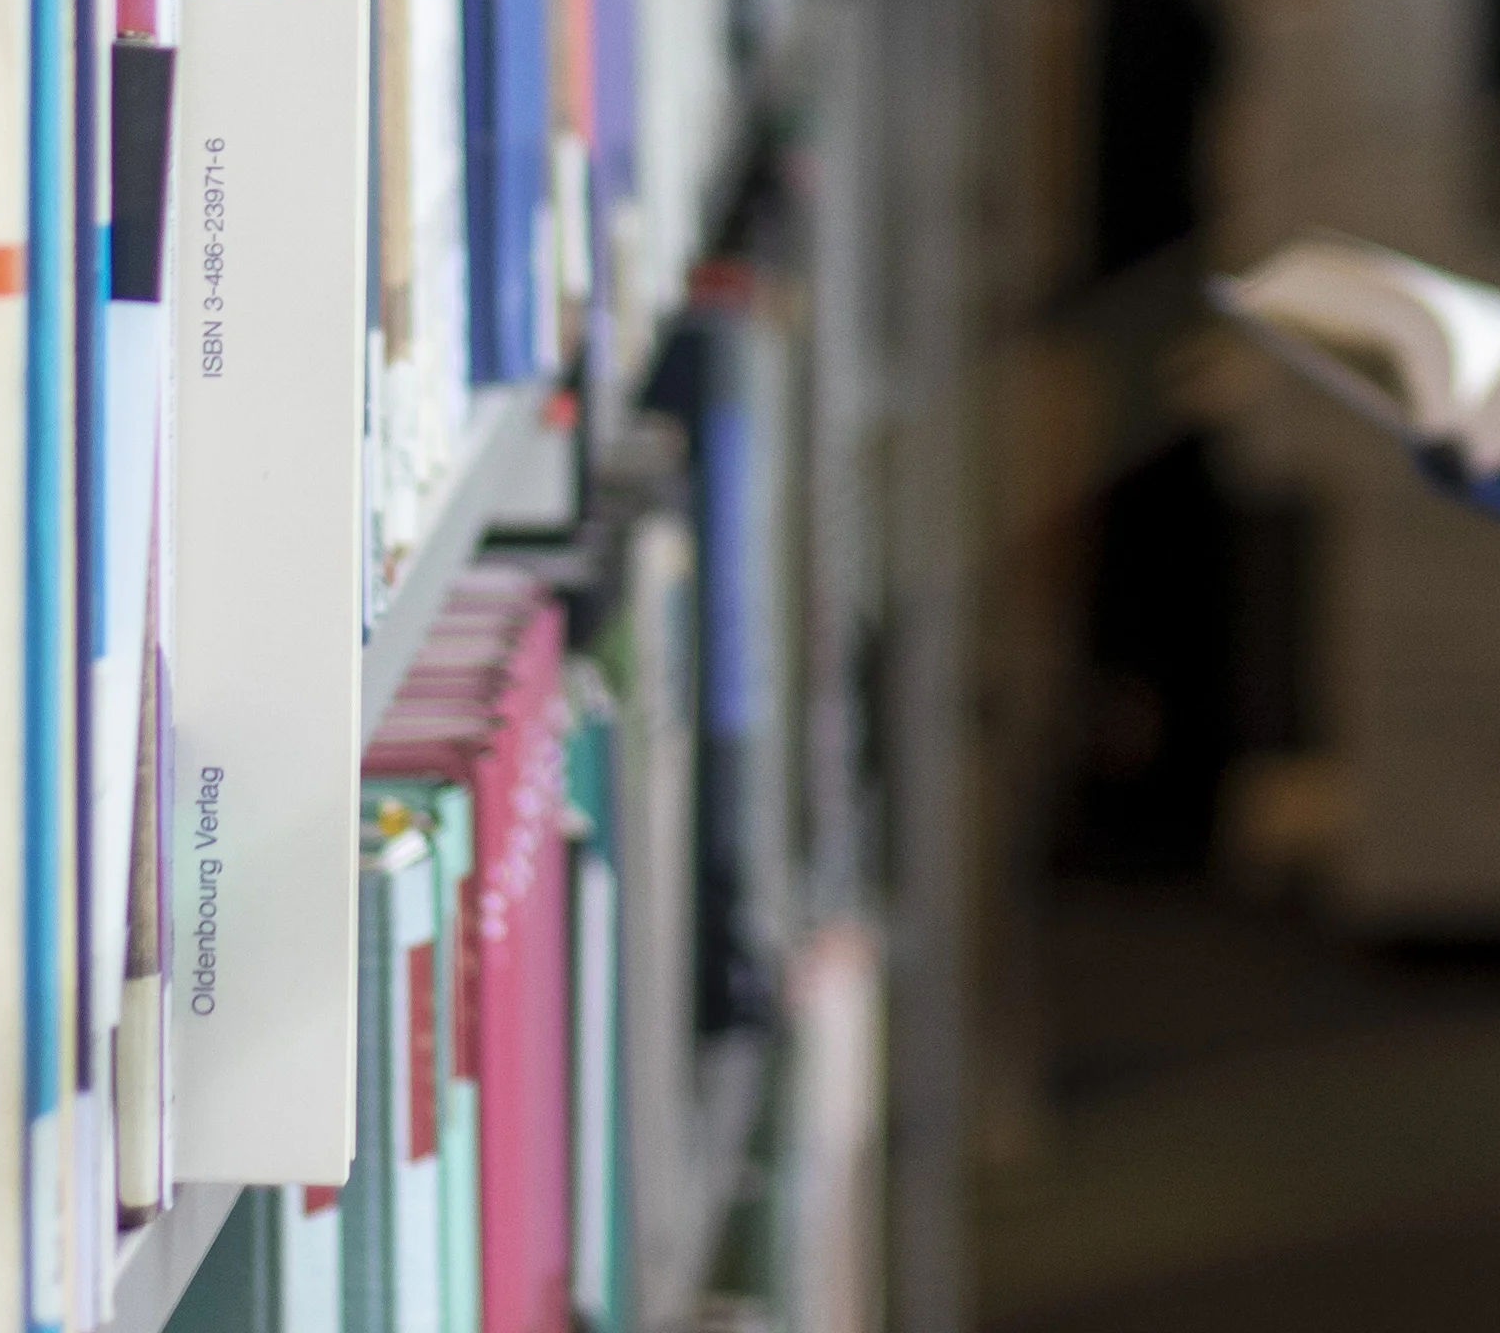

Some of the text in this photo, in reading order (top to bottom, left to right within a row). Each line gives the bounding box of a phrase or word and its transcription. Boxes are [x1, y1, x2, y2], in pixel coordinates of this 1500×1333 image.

[202, 136, 227, 379] ISBN 3-486-23971-6
[190, 764, 223, 1017] Oldenbourg Verlag
